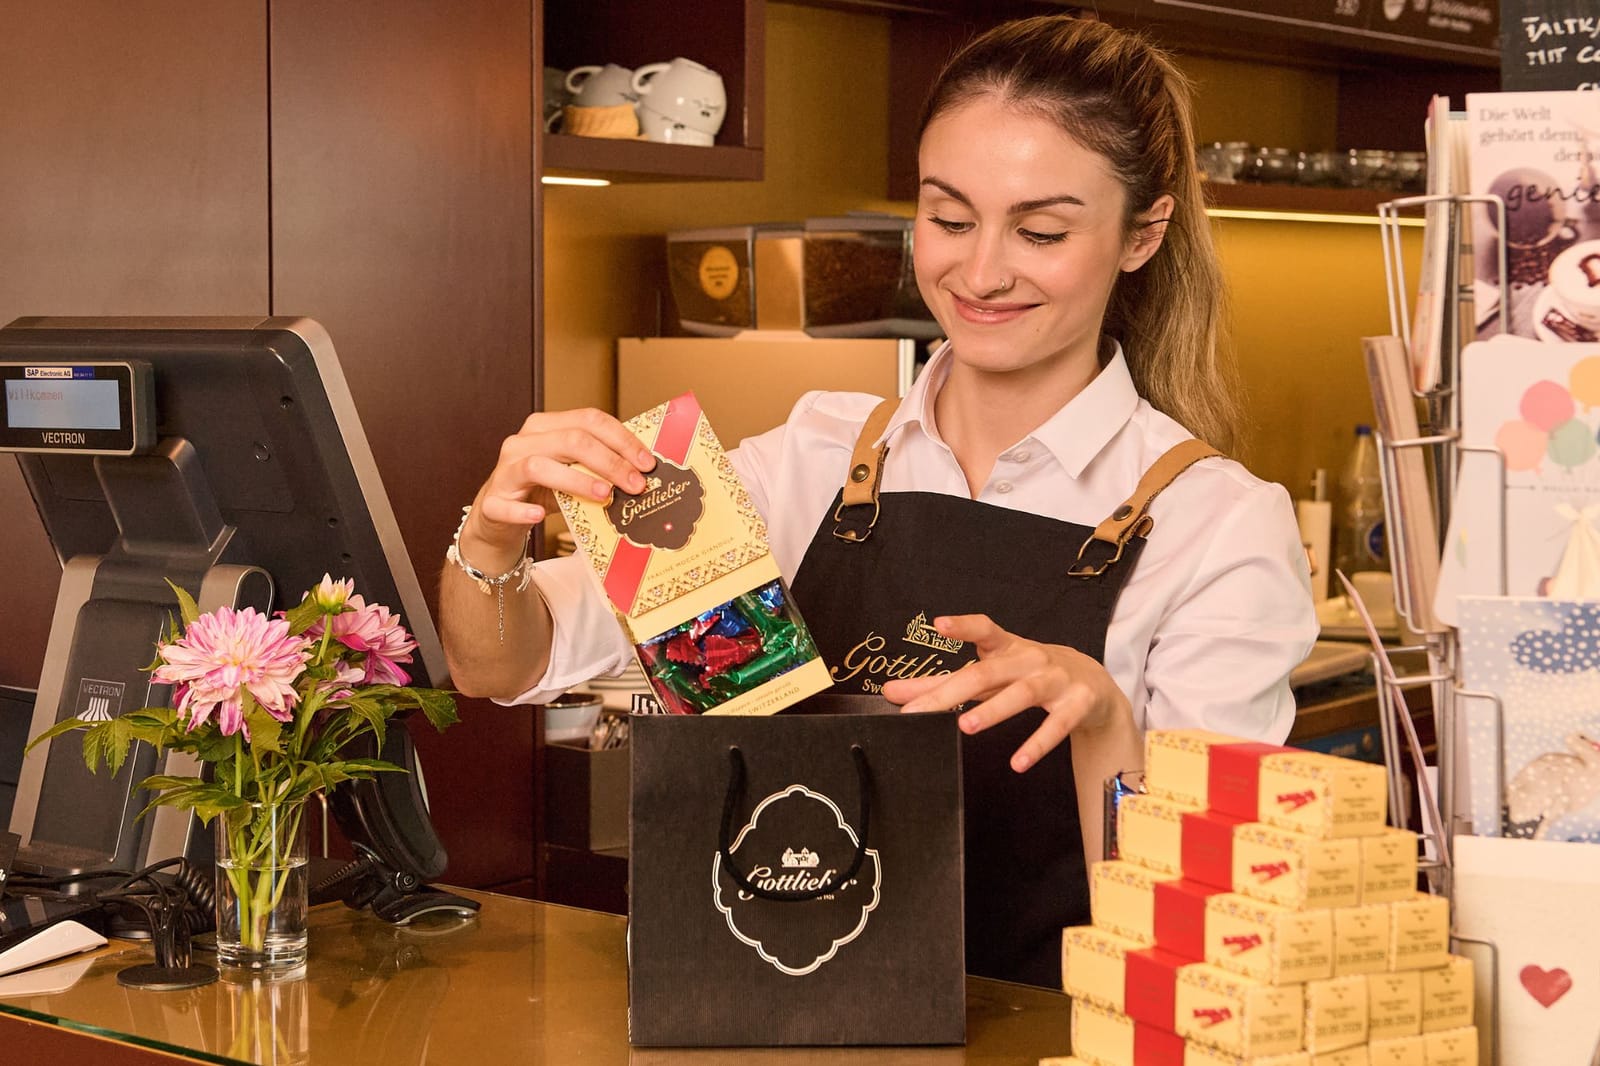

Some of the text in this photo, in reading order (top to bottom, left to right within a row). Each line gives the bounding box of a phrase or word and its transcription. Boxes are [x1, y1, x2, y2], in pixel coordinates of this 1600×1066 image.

[1526, 46, 1567, 66] MIT
[1480, 106, 1551, 121] Die Welt
[1480, 127, 1534, 146] gehört
[26, 368, 39, 377] SAP
[63, 369, 71, 377] AG
[42, 432, 86, 445] VECTRON
[621, 480, 690, 526] Gottlieber
[82, 682, 121, 697] VECTRON
